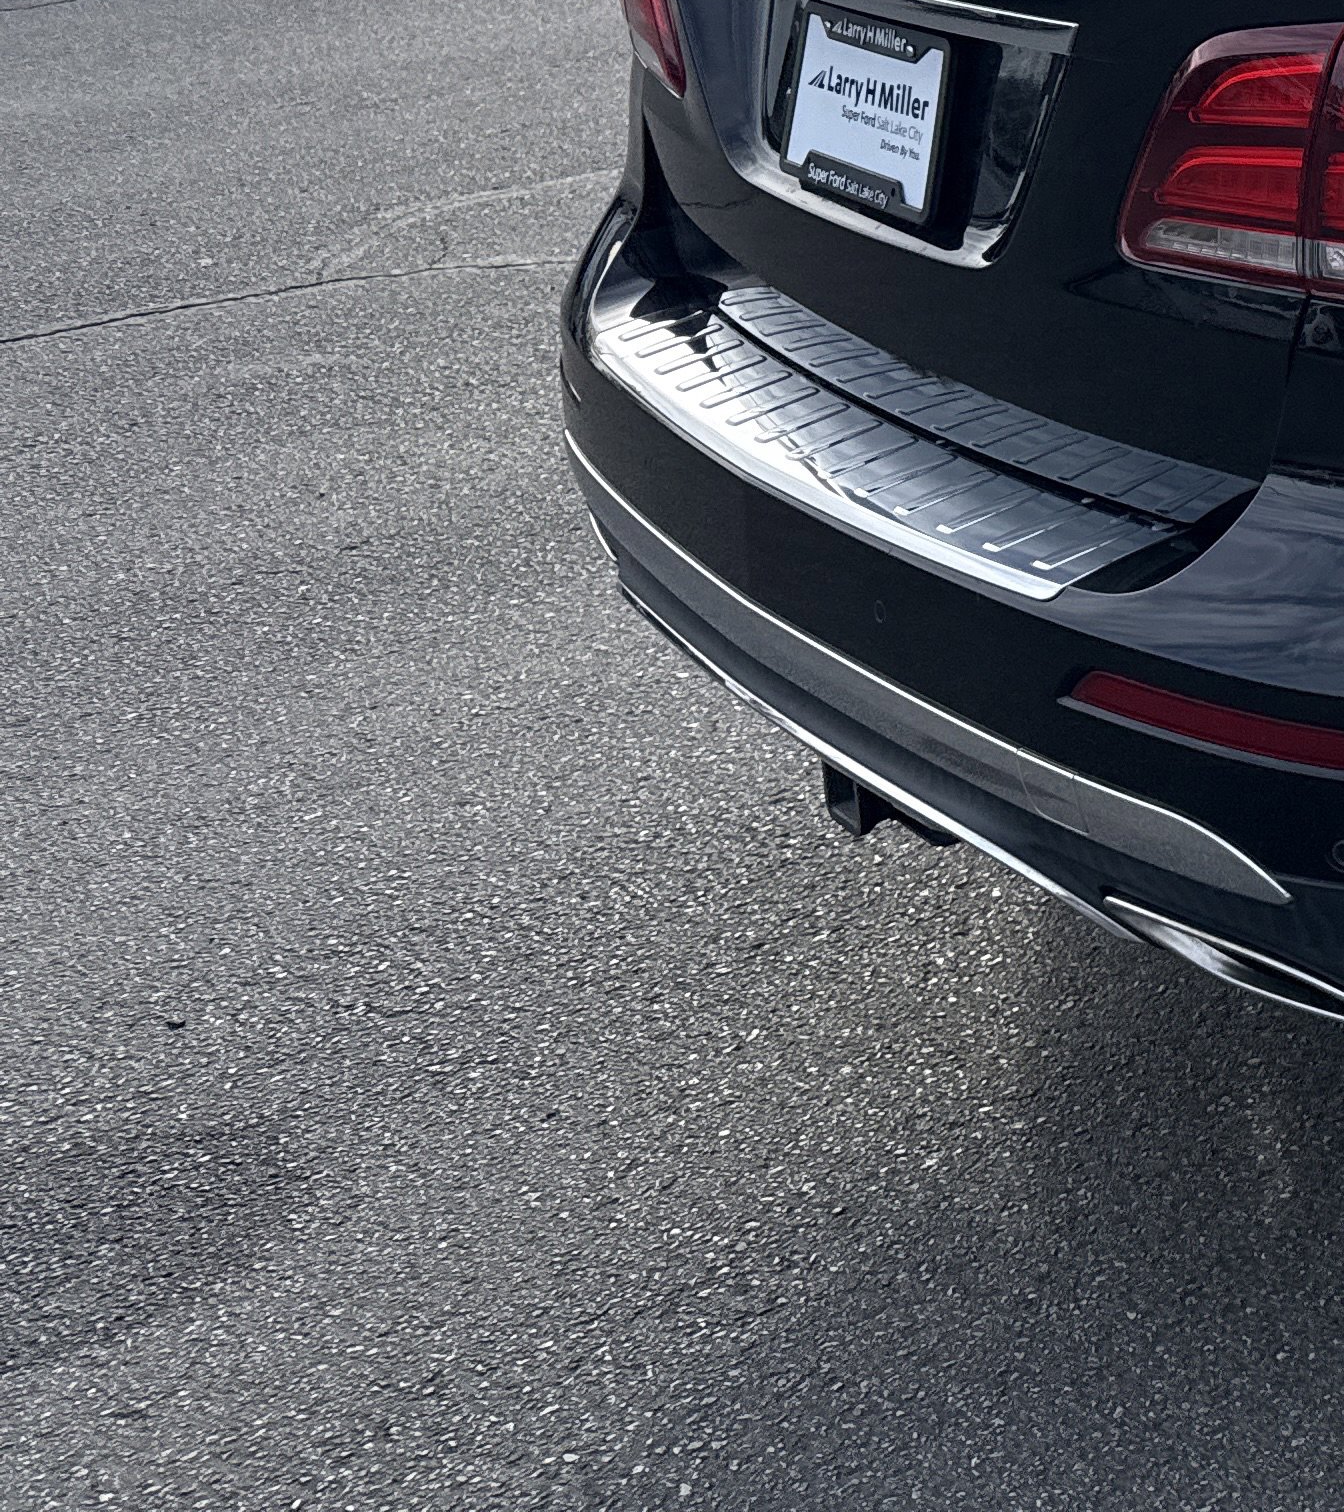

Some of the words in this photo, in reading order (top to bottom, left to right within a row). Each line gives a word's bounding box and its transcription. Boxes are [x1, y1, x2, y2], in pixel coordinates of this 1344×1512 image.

[842, 17, 866, 46] Larry
[866, 24, 875, 44] H
[875, 27, 907, 52] Miller
[827, 65, 864, 107] Larry
[864, 77, 877, 106] H
[878, 81, 930, 121] Miller
[841, 104, 860, 123] Super
[860, 110, 876, 128] Ford
[876, 116, 890, 133] Salt
[890, 120, 908, 138] Lake
[908, 125, 924, 145] City
[807, 162, 829, 185] Super
[828, 170, 847, 190] Ford
[874, 189, 889, 209] City
